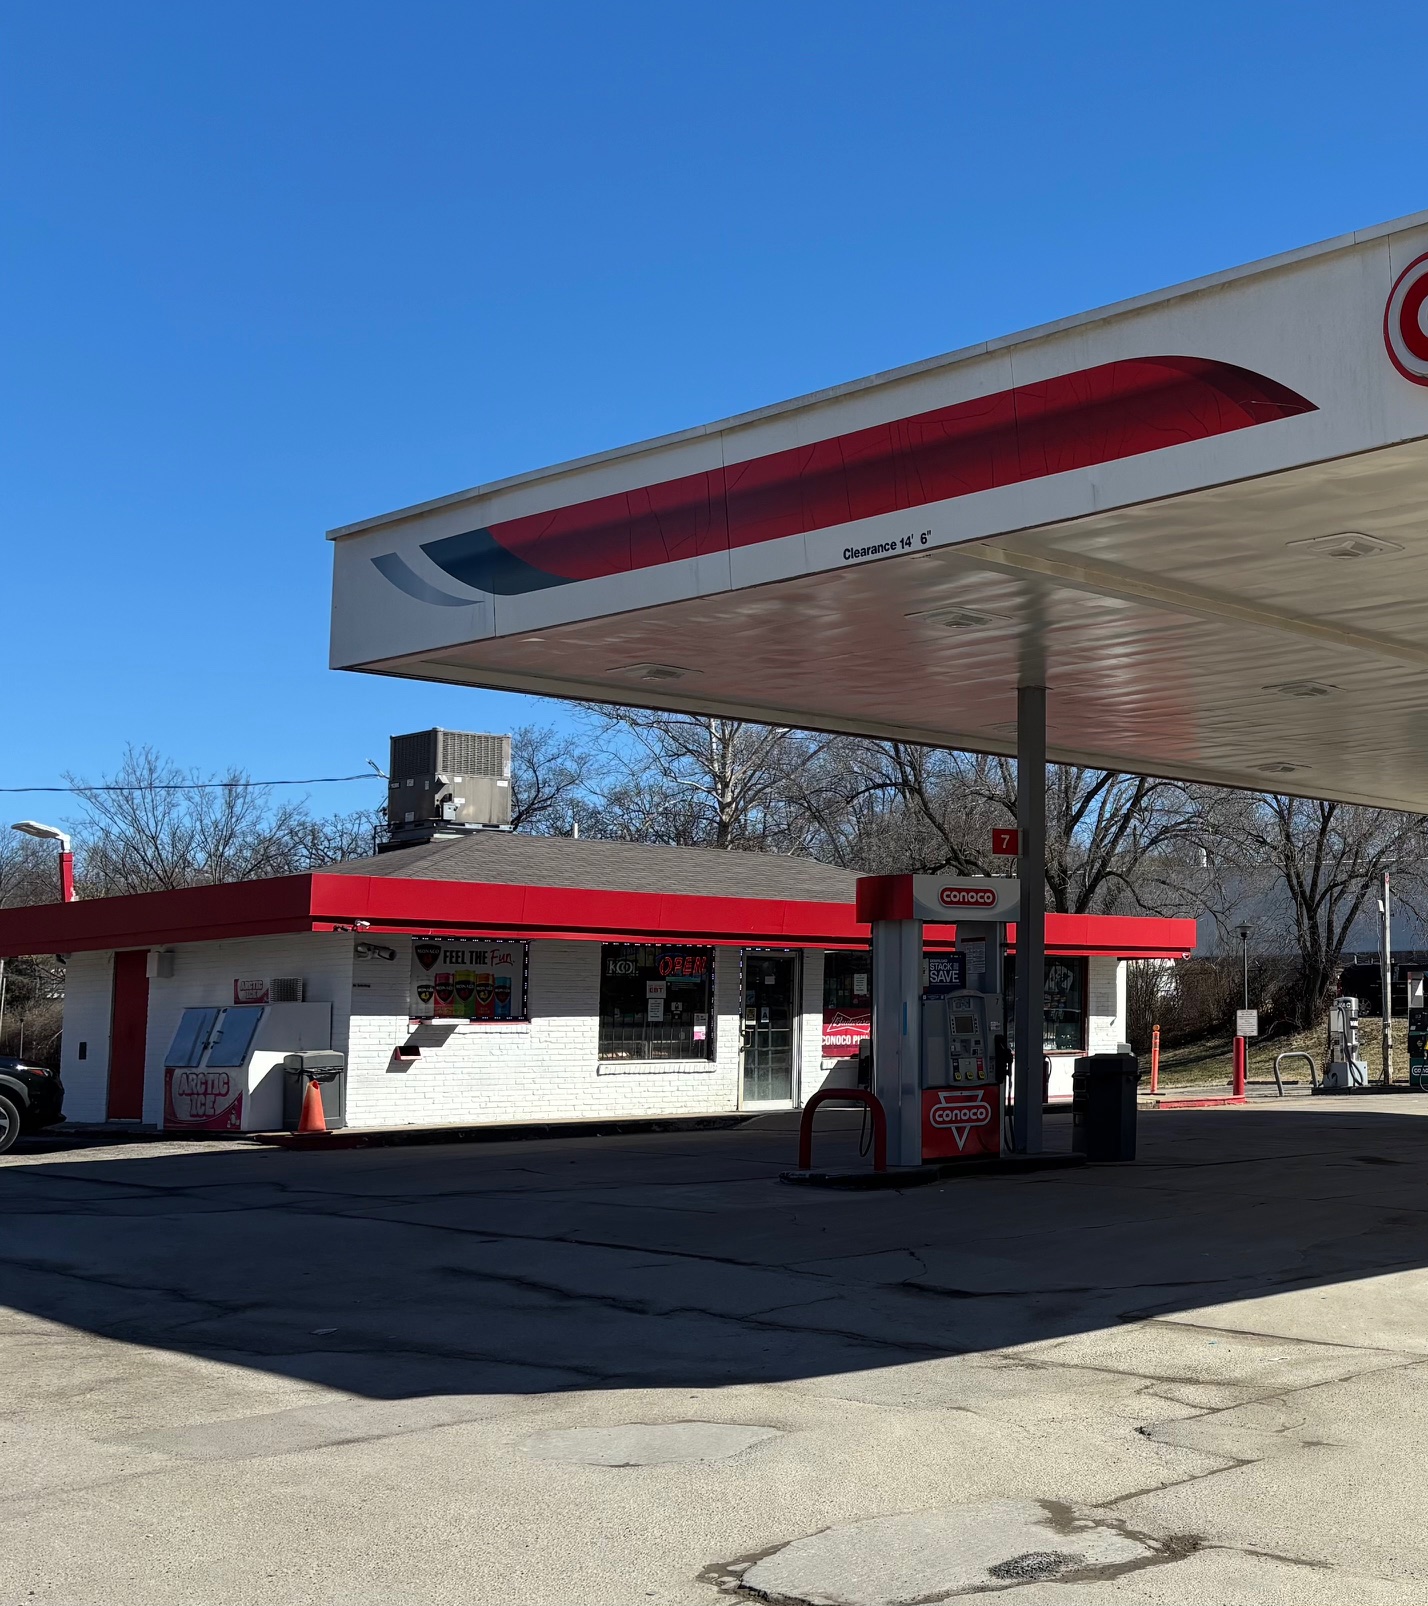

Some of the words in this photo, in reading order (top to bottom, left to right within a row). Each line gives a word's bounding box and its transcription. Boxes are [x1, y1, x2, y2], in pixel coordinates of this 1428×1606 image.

[843, 541, 897, 560] Clearance
[899, 533, 914, 550] 14'
[920, 529, 932, 545] 6"
[1000, 834, 1010, 849] 7
[443, 949, 467, 965] FEEL
[469, 950, 488, 966] THE
[658, 956, 708, 976] OPEN
[929, 962, 953, 970] STACK
[929, 970, 960, 983] SAVE
[240, 980, 264, 991] ARCTIC
[832, 1016, 870, 1027] Budweise
[822, 1035, 852, 1046] CONOCO
[178, 1072, 230, 1097] ARCTIC
[189, 1095, 217, 1118] ICE
